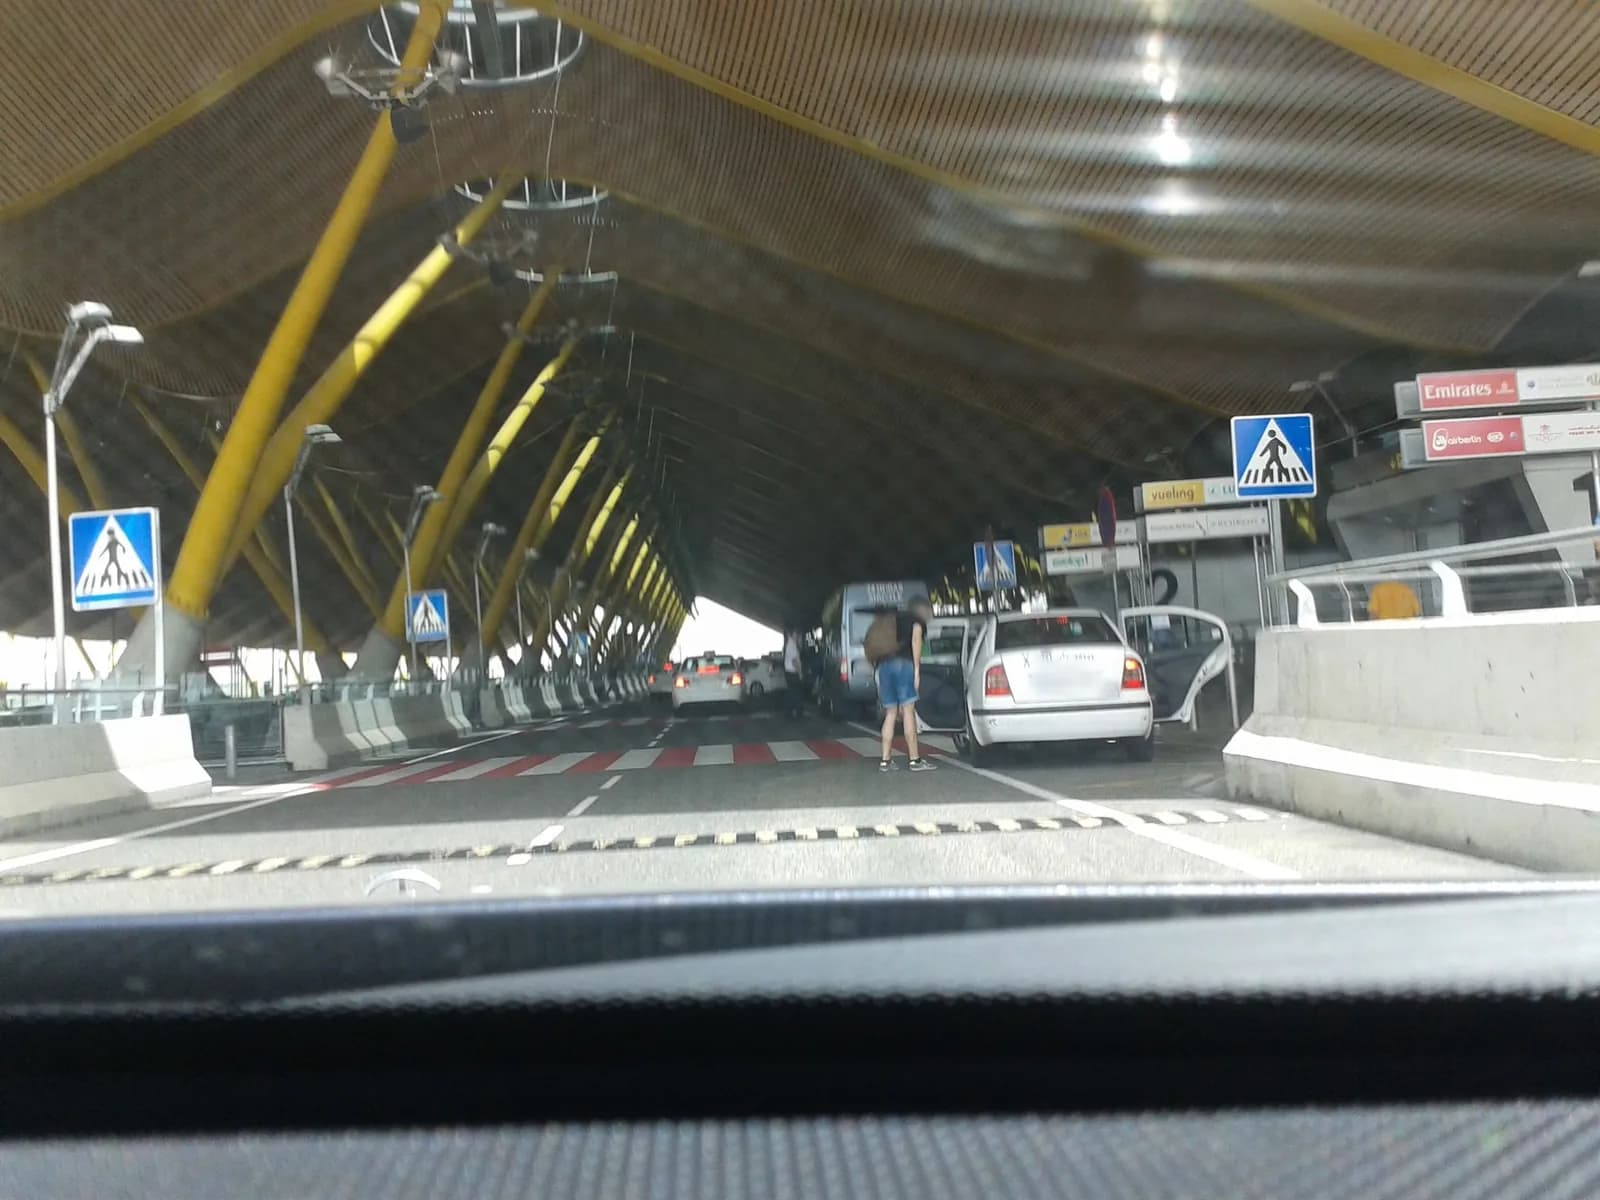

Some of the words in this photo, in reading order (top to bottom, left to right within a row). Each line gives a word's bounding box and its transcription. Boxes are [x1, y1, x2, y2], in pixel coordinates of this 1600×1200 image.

[1424, 382, 1493, 400] Emirates
[1447, 434, 1482, 446] airberlin
[1151, 485, 1195, 501] vueling
